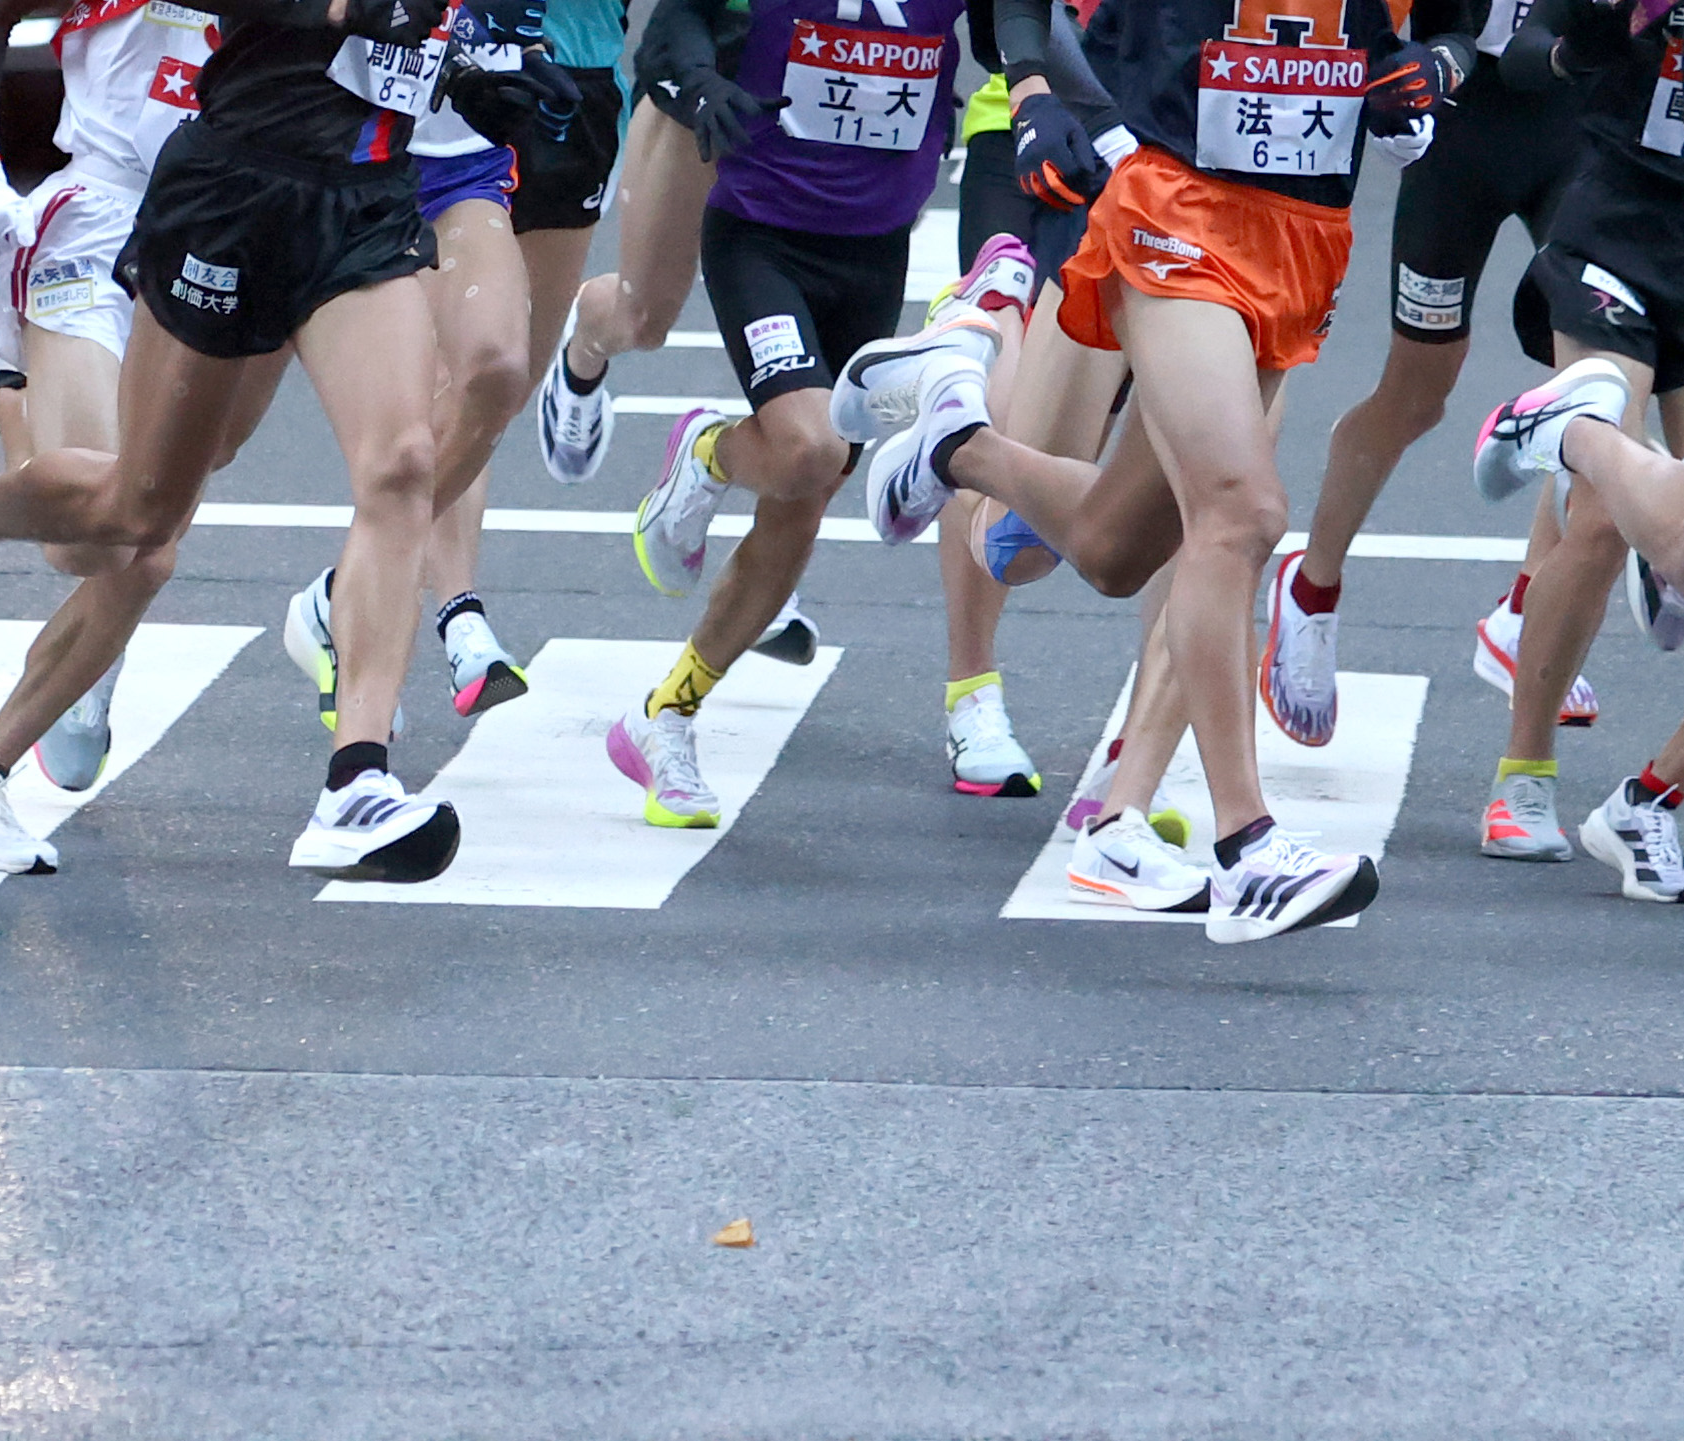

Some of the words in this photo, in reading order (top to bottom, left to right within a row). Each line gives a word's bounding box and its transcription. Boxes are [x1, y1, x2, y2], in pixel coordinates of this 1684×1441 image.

[1243, 56, 1364, 88] SAPPORO
[379, 75, 418, 110] 8-1
[818, 76, 921, 117] 立大
[833, 115, 900, 145] 11-1
[1236, 97, 1335, 140] 法大
[1252, 140, 1317, 171] 6-11
[1132, 228, 1203, 260] ThreeBond
[184, 260, 237, 288] 創友会
[171, 277, 239, 316] 創価大学
